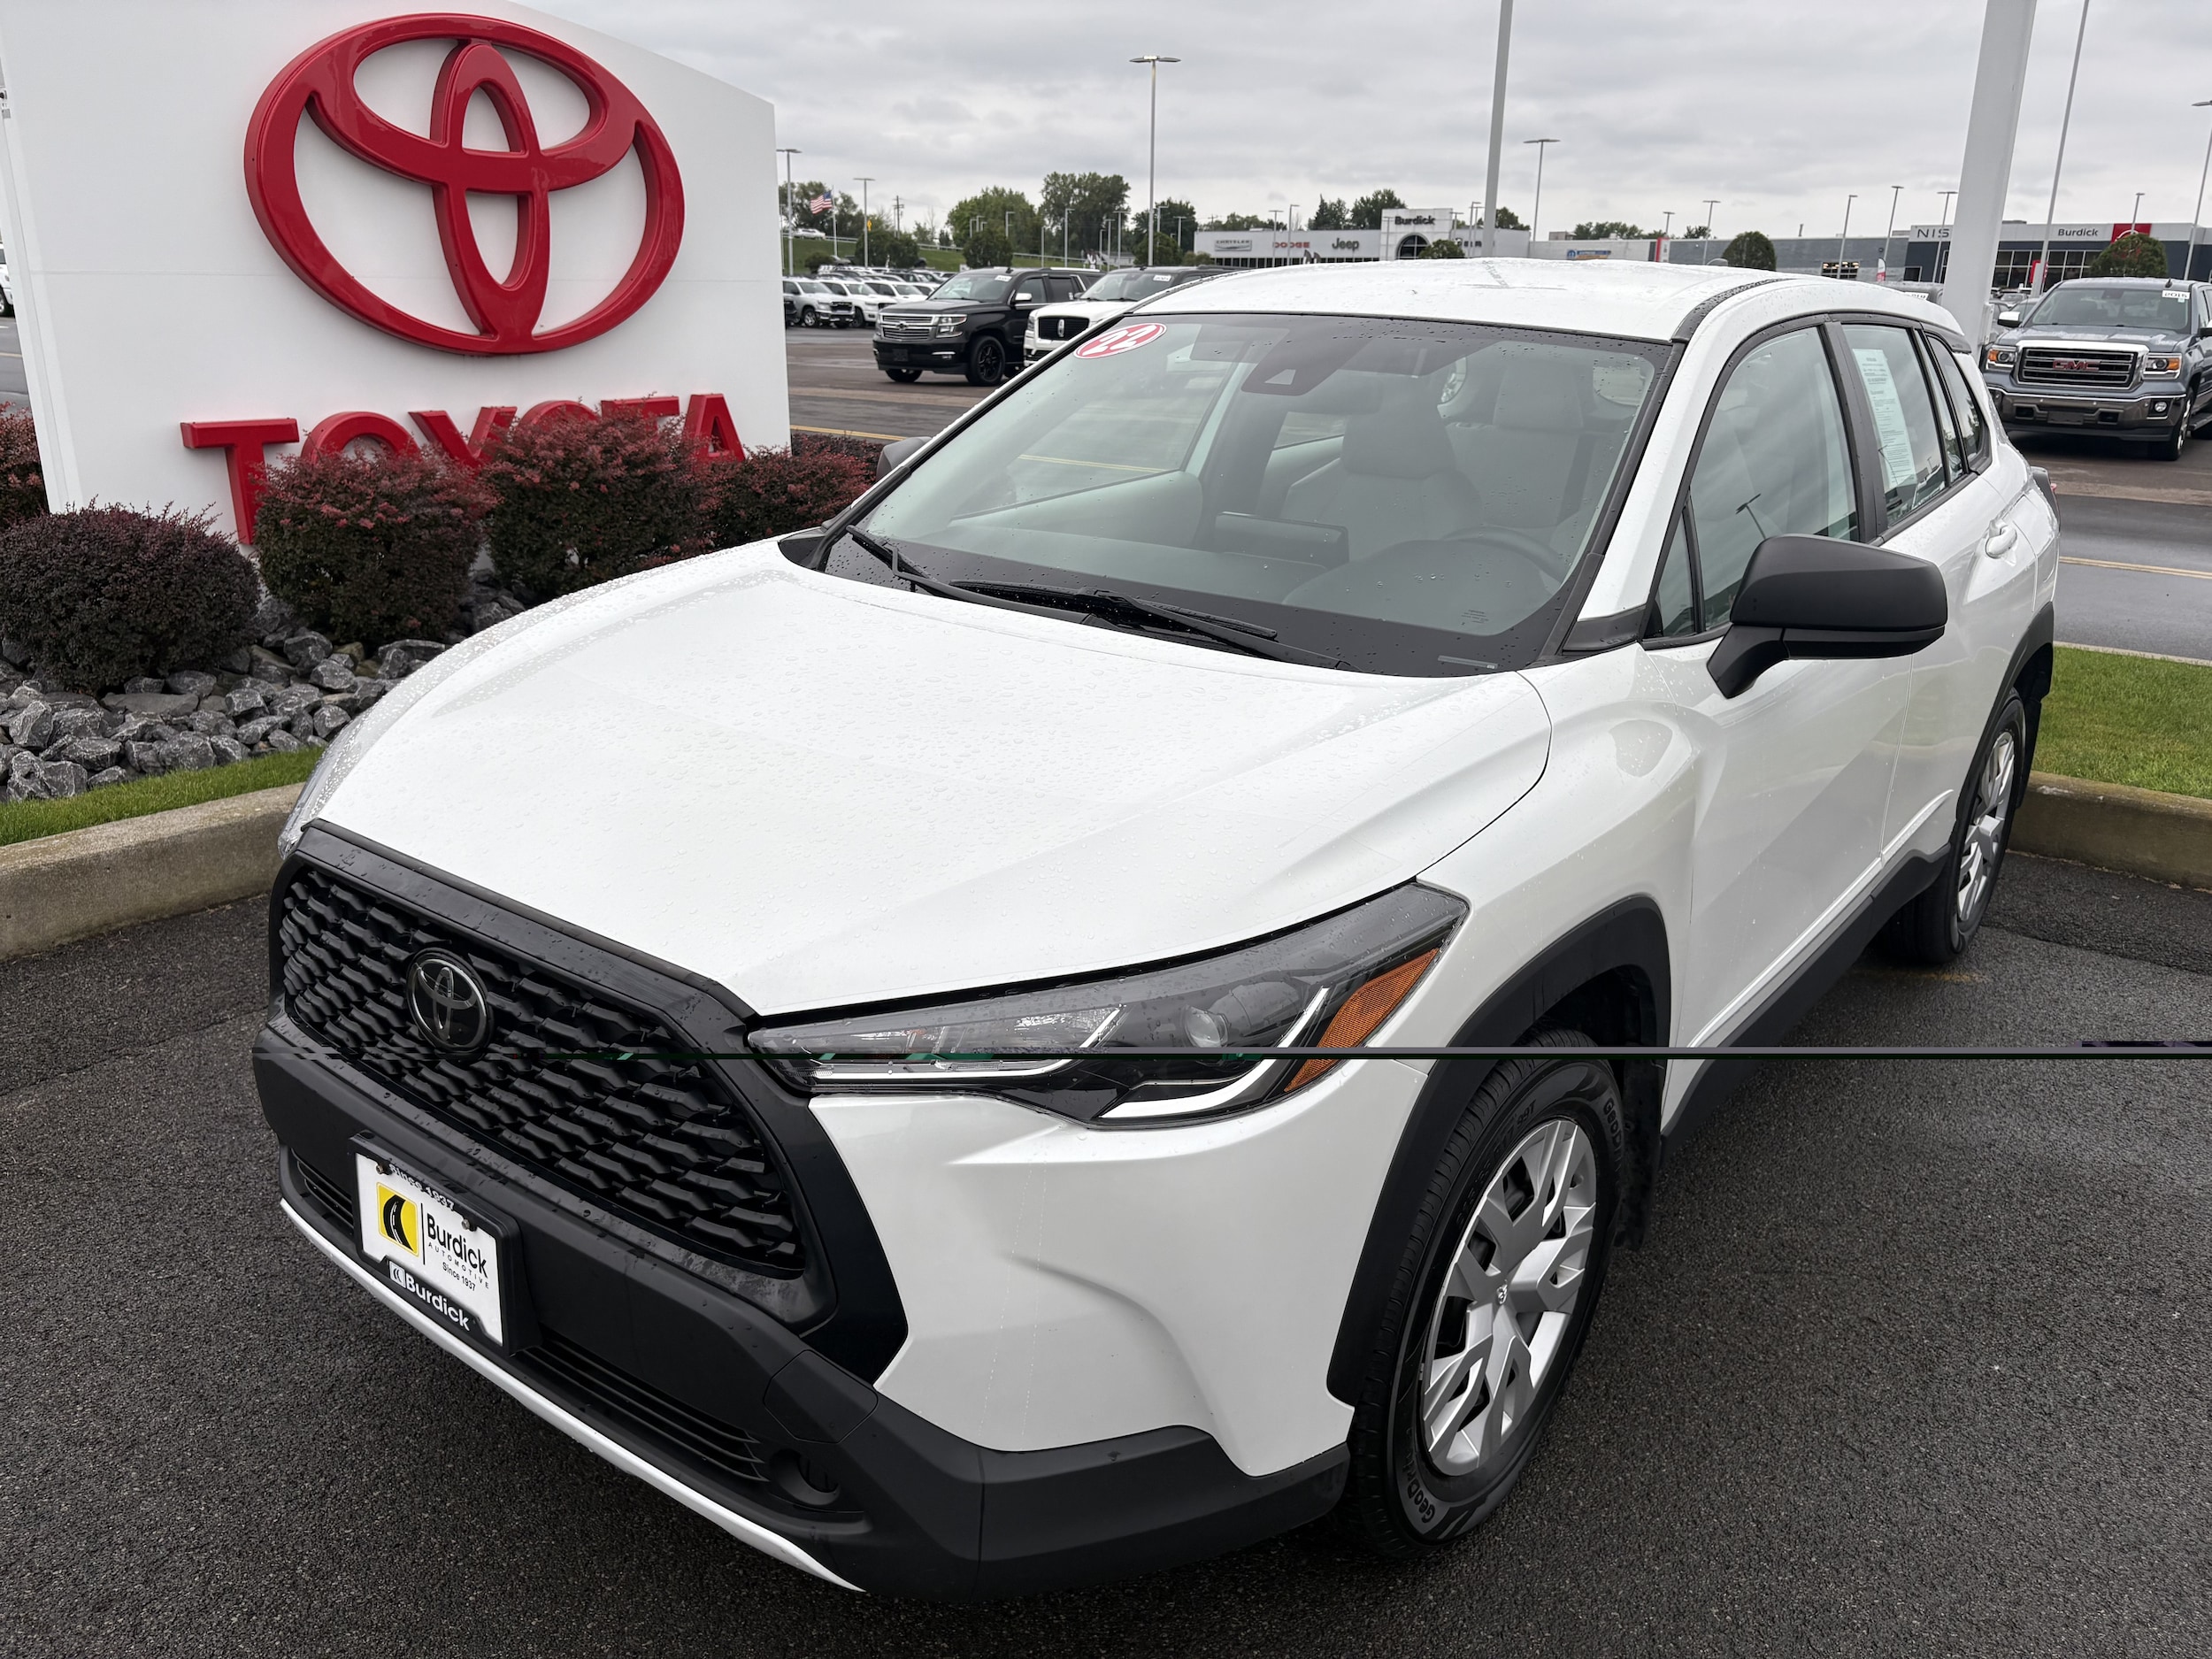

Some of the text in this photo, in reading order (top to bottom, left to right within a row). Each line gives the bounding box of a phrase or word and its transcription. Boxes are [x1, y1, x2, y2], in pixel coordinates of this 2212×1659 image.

[1394, 215, 1435, 225] Burdick
[1916, 228, 1950, 238] NIS
[1332, 238, 1360, 250] Jeep
[1081, 324, 1158, 356] 22
[2053, 359, 2101, 371] GMC
[180, 393, 748, 545] TOYTA
[389, 1164, 455, 1211] Since 1937
[426, 1213, 488, 1279] Burdick
[428, 1242, 489, 1288] AUTOMOTIVE
[442, 1262, 476, 1292] Since 1937
[405, 1271, 470, 1332] Burdick
